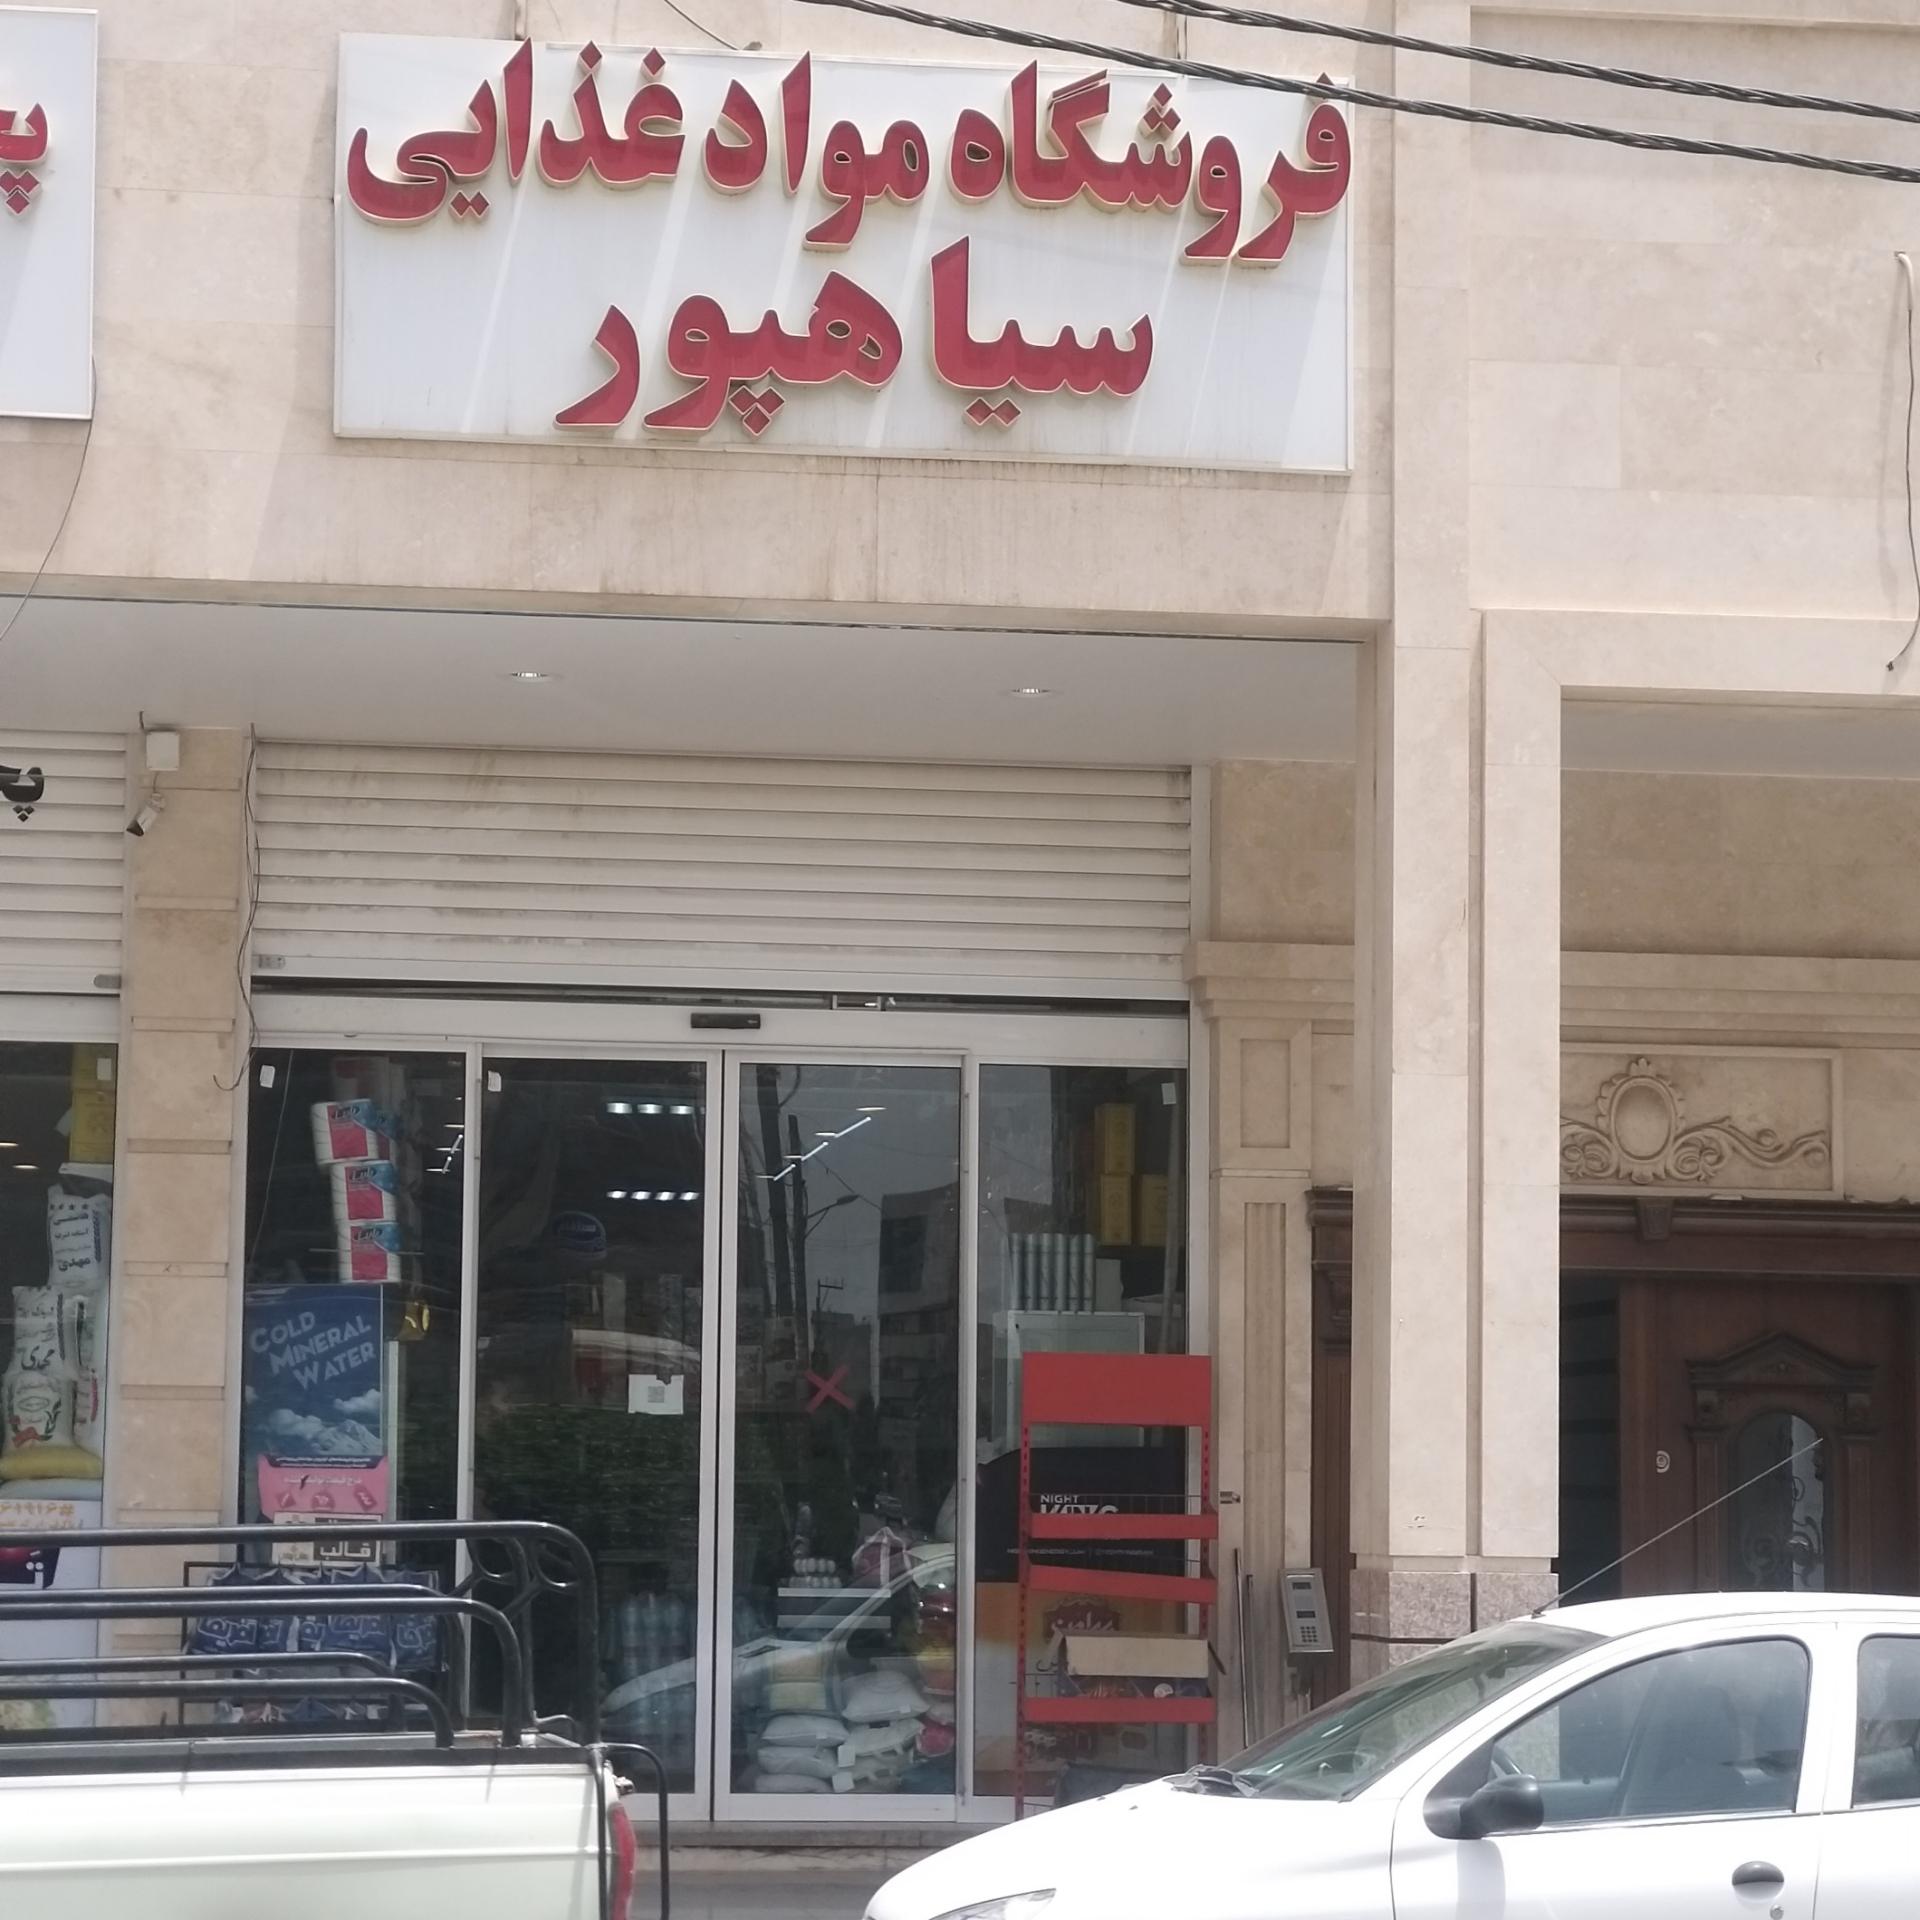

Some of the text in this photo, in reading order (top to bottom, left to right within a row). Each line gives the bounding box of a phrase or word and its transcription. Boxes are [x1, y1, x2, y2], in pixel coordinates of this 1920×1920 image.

[347, 40, 1351, 267] فروشگاه مواد غذایی
[250, 1310, 316, 1353] COLD
[268, 1314, 372, 1376] MINERAL
[293, 1341, 377, 1390] WATER
[1040, 1494, 1079, 1504] NIGHT
[319, 1540, 372, 1561] قالب
